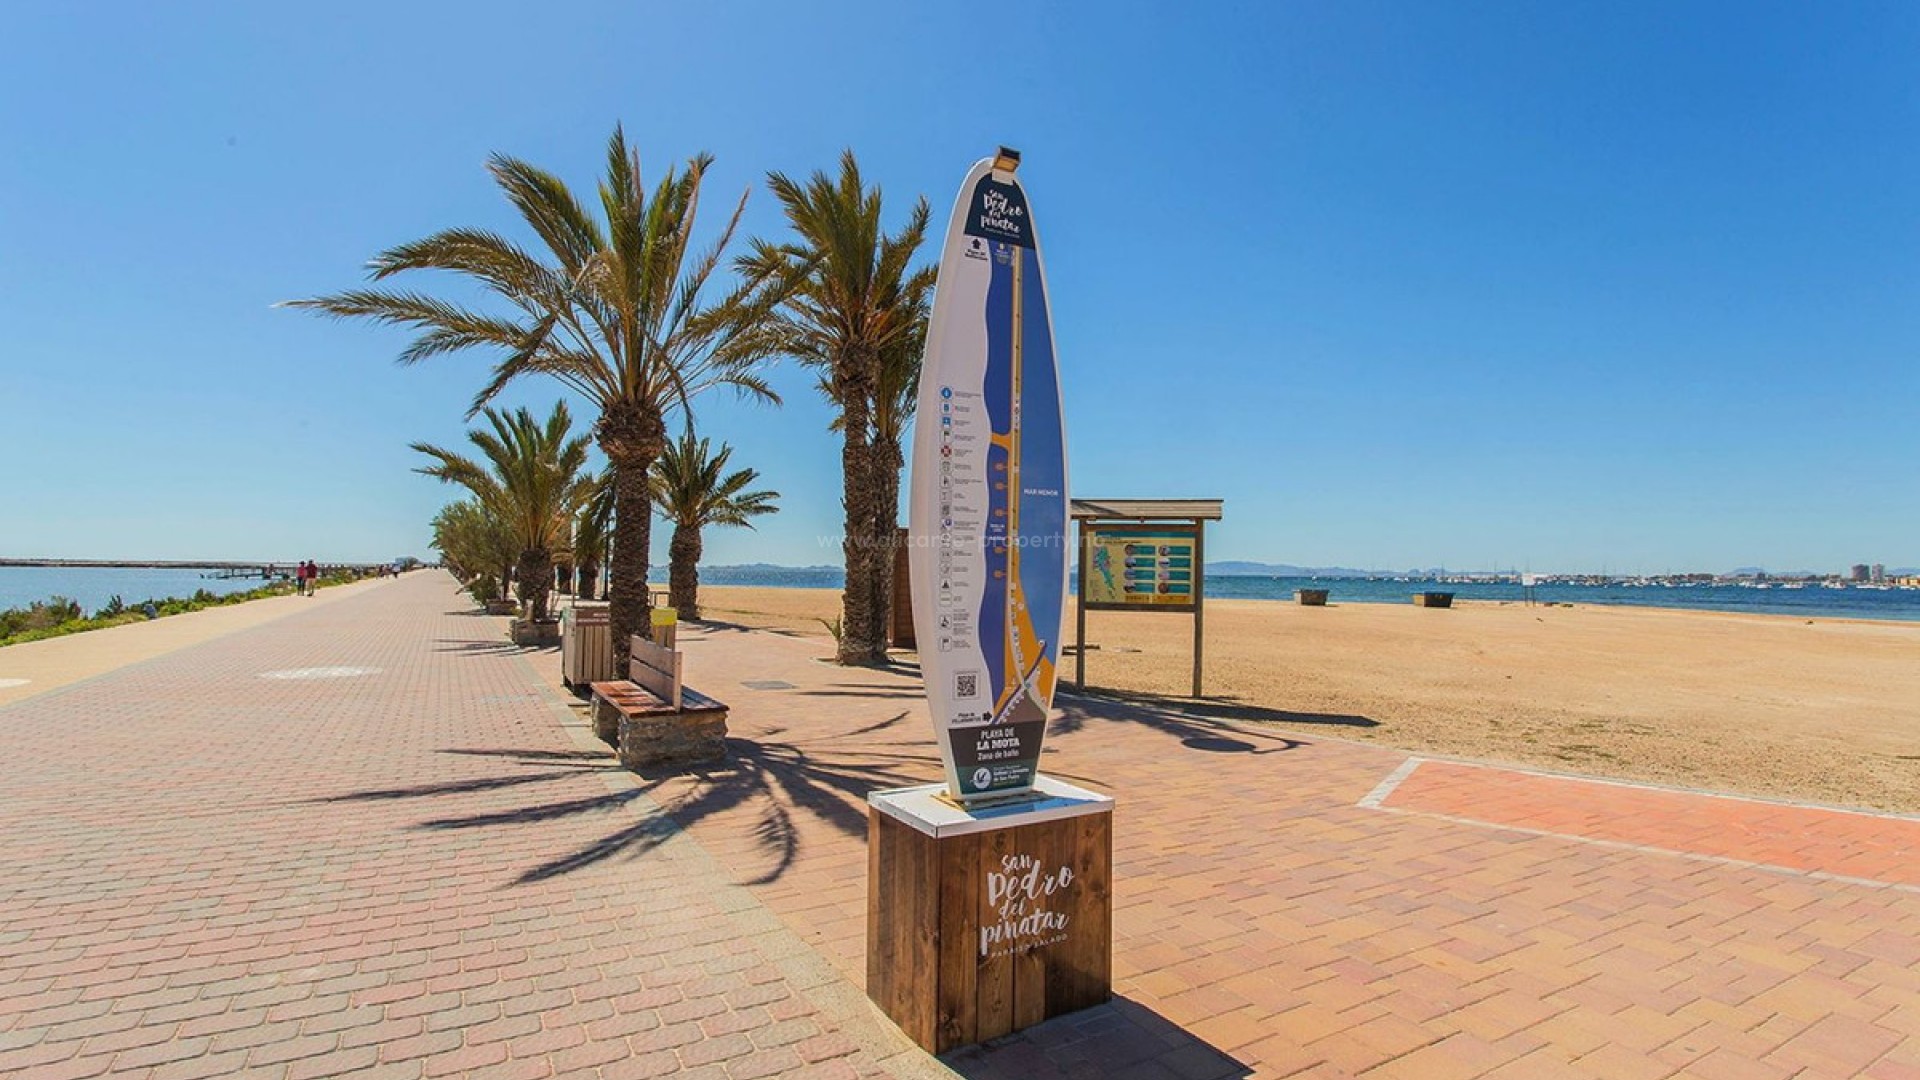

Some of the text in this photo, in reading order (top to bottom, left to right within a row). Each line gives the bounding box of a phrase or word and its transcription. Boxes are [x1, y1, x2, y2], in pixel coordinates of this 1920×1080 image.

[1023, 488, 1037, 496] MAR
[980, 727, 1015, 739] PLAYA DE
[976, 737, 1020, 751] LA MOTA
[977, 752, 993, 761] Zona
[994, 750, 1002, 759] de
[999, 897, 1026, 920] del
